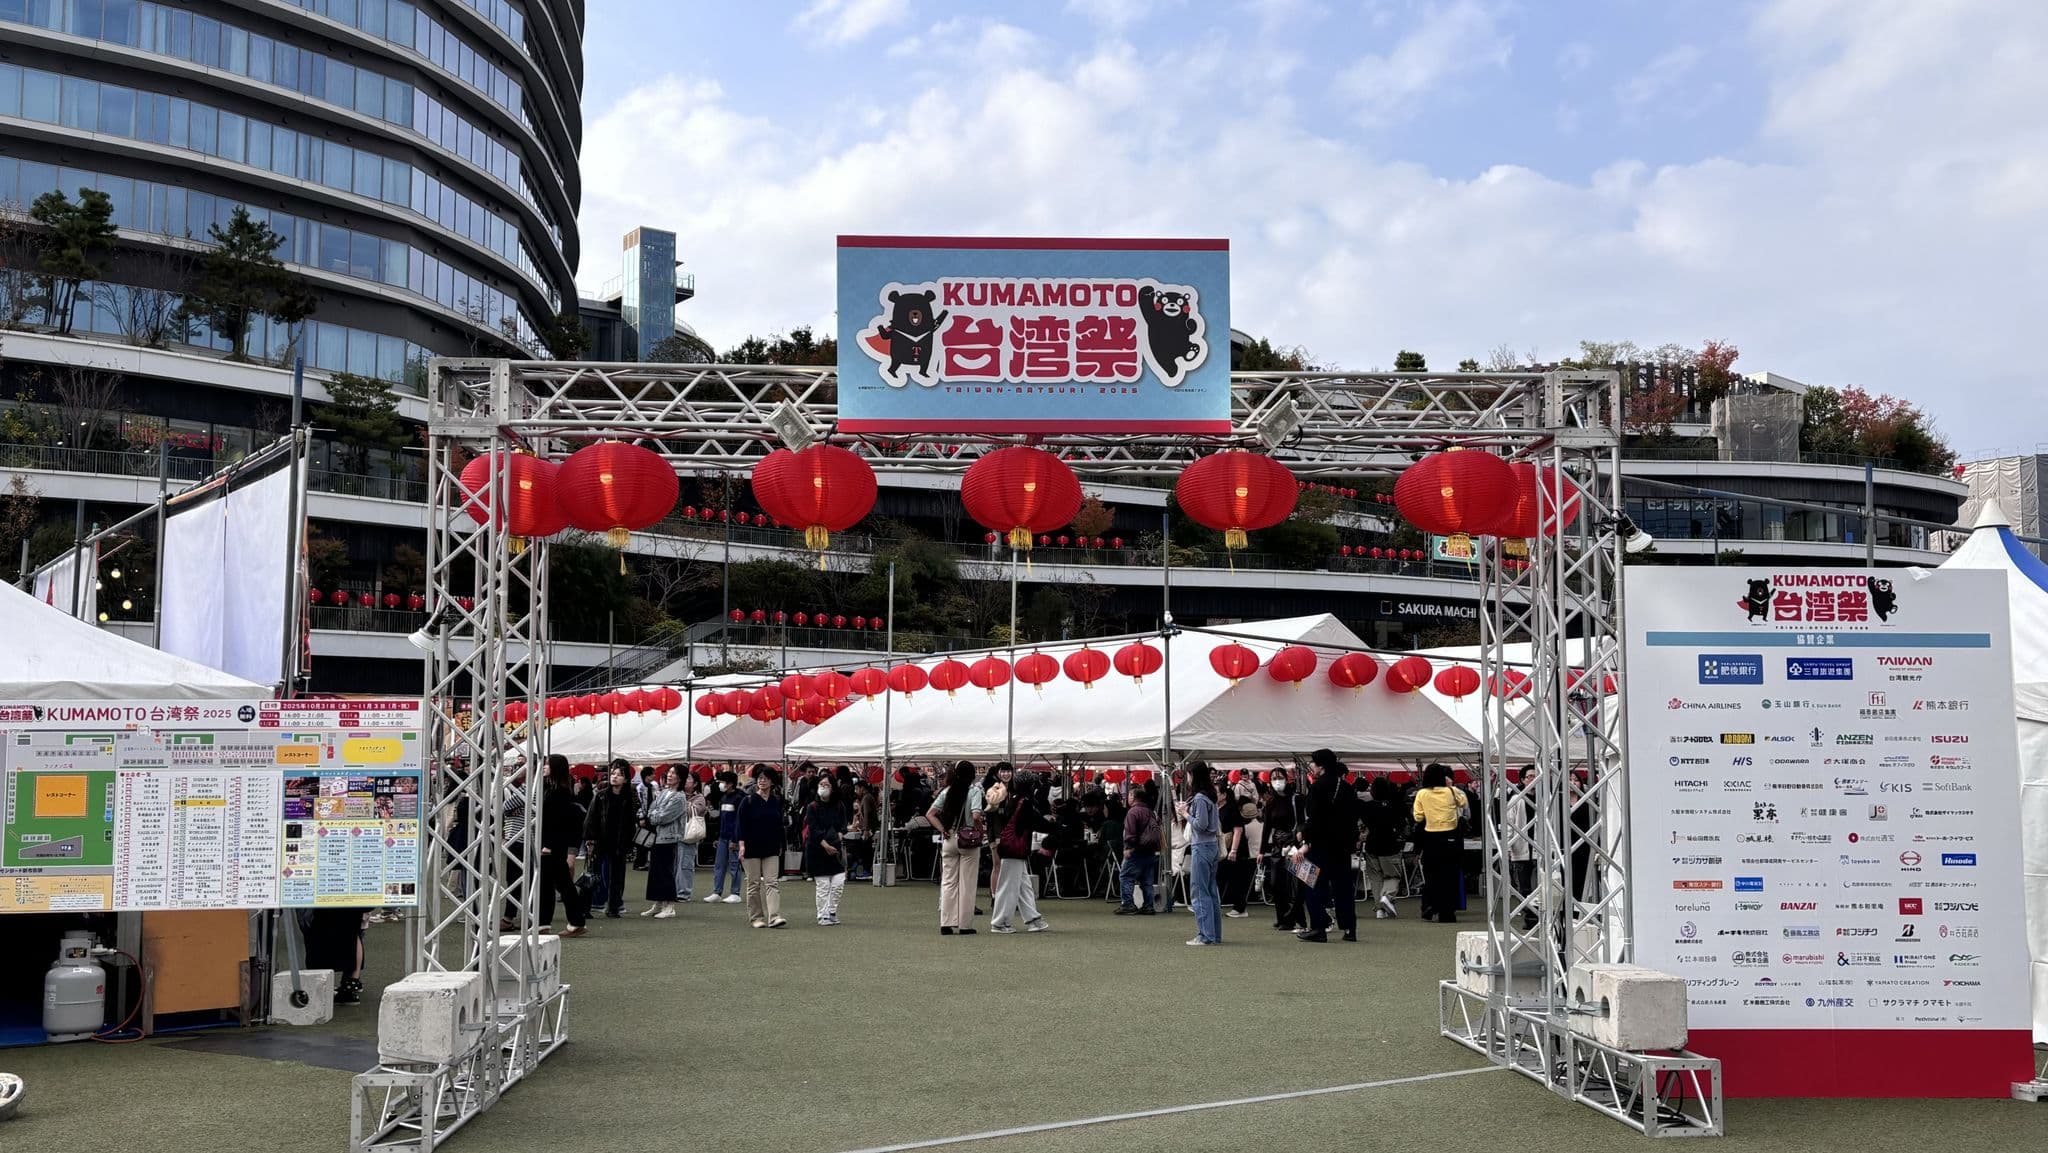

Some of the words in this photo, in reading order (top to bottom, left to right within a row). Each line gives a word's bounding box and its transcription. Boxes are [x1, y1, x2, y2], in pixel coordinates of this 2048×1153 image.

[943, 282, 1138, 307] KUMAMOTO
[942, 315, 1139, 378] 台湾祭
[1773, 575, 1868, 586] KUMAMOTO
[1398, 602, 1442, 616] SAKURA
[1444, 606, 1476, 618] MACHI
[1773, 591, 1868, 622] 台湾祭
[1877, 657, 1932, 666] TAIWAN
[1720, 666, 1757, 676] 肥後銀行
[1927, 701, 1969, 710] 熊本銀行
[48, 708, 146, 721] KUMAMOTO
[150, 706, 200, 721] 台湾祭
[203, 710, 232, 718] 2025
[1892, 783, 1912, 792] KIS
[1935, 783, 1972, 791] SoftBank
